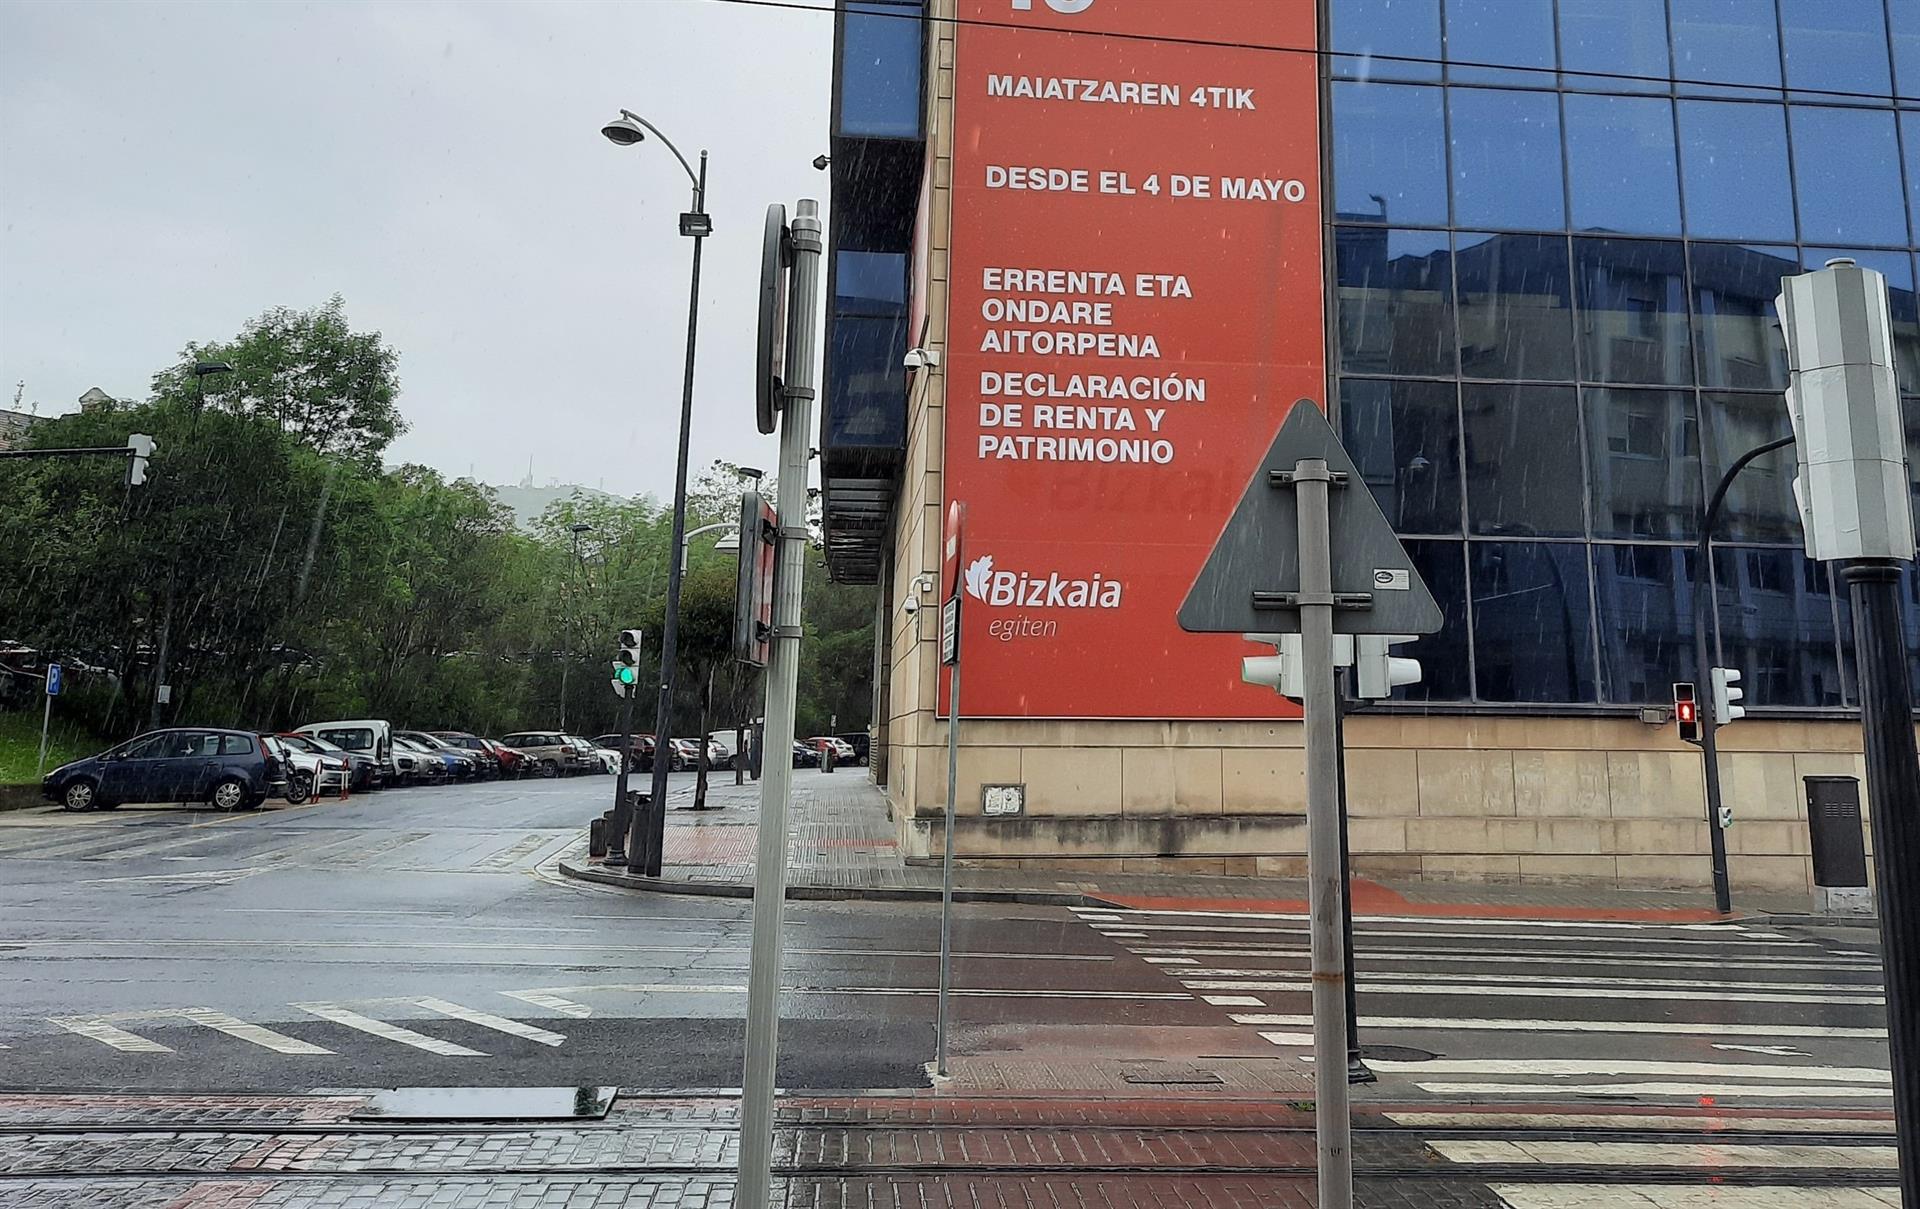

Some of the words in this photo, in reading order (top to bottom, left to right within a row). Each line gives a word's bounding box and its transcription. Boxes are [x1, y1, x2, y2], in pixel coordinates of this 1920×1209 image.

[987, 74, 1180, 106] MAIATZAREN
[1189, 86, 1256, 110] 4TIK
[986, 165, 1089, 193] DESDE
[1099, 171, 1137, 195] EL
[1142, 174, 1161, 196] 4
[1170, 174, 1211, 198] DE
[1220, 176, 1306, 203] MAYO
[983, 267, 1126, 296] ERRENTA
[1135, 274, 1193, 298] ETA
[981, 298, 1113, 326] ONDARE
[979, 329, 1161, 358] AITORPENA
[980, 371, 1206, 402] DECLARACIÓN
[979, 403, 1023, 428] DE
[1033, 404, 1137, 431] RENTA
[1144, 408, 1166, 432] Y
[978, 434, 1174, 464] PATRIMONIO
[990, 571, 1122, 608] Bizkaia
[989, 614, 1057, 641] egiten
